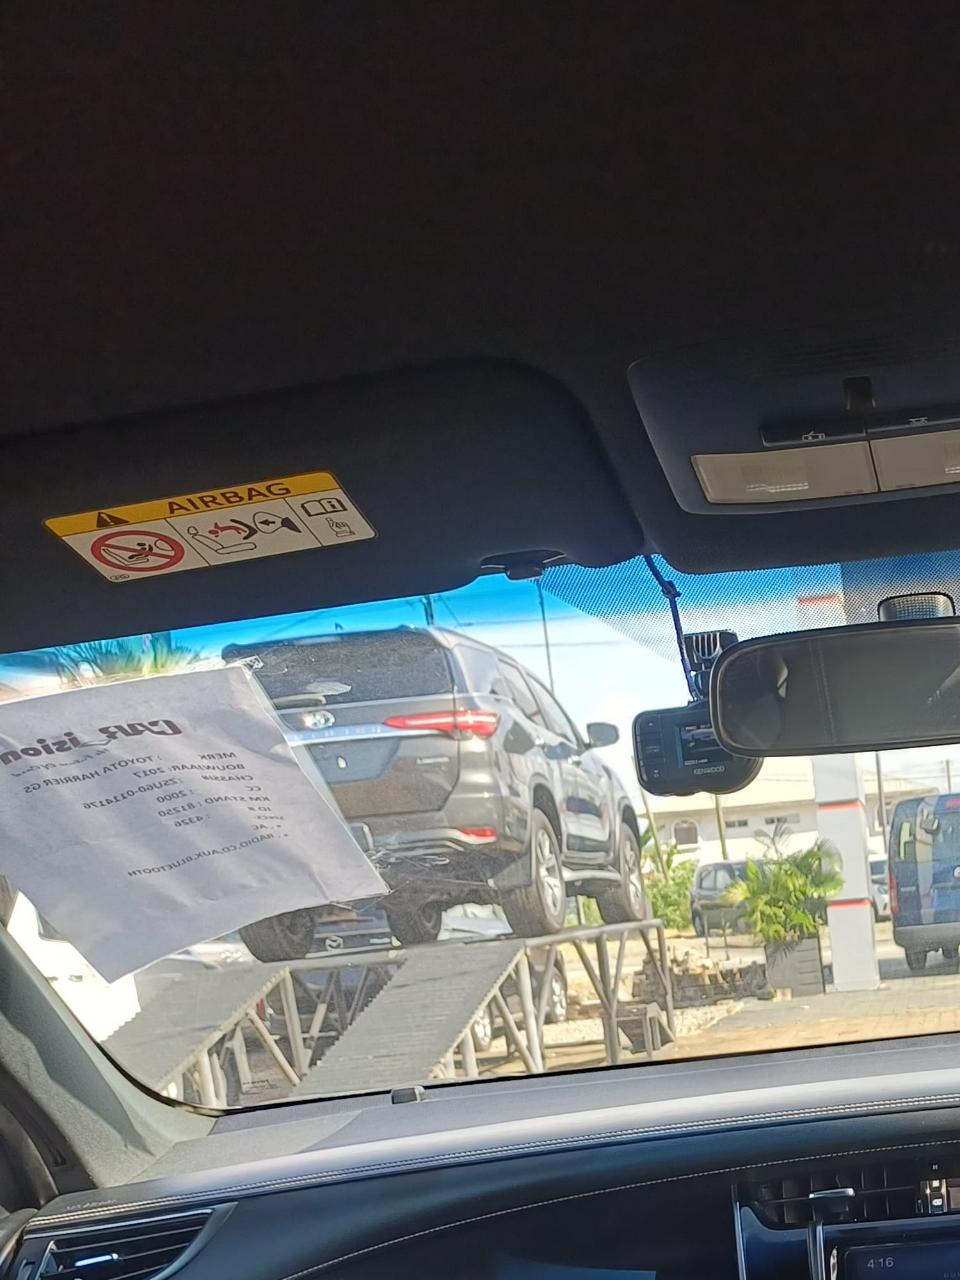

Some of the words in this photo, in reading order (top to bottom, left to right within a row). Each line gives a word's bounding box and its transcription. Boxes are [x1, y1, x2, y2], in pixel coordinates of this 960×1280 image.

[168, 482, 291, 514] AIRBAG
[693, 765, 725, 775] KENWOOD
[867, 1256, 894, 1270] 4:16
